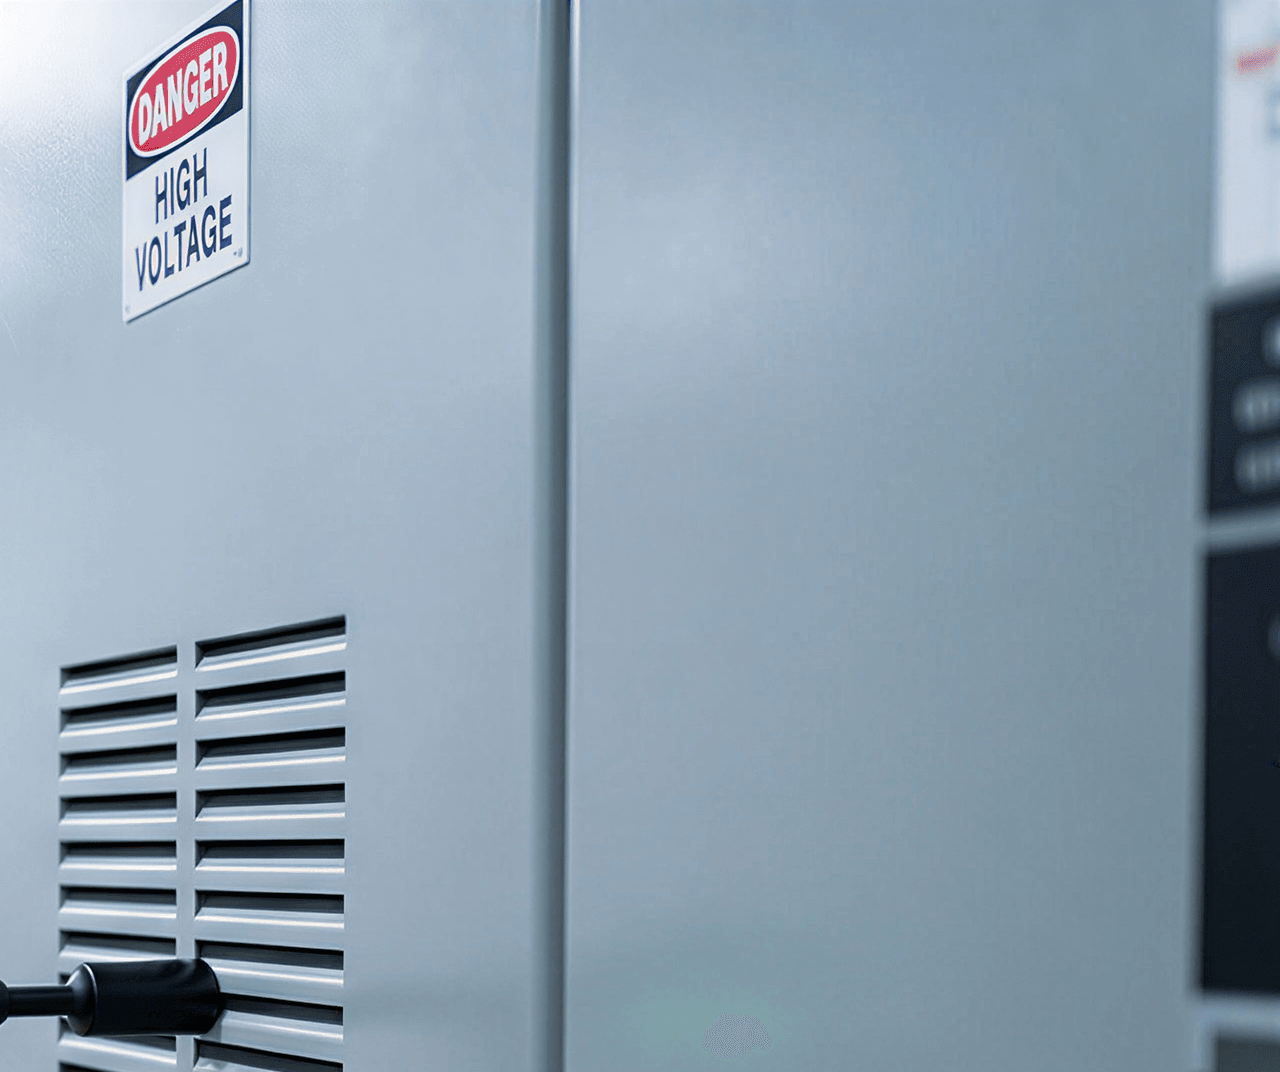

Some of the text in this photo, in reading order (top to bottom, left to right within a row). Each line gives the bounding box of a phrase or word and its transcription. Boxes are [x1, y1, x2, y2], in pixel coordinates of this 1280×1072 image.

[137, 41, 230, 147] DANGER
[154, 147, 208, 225] HIGH
[134, 193, 234, 293] VOLTAGE
